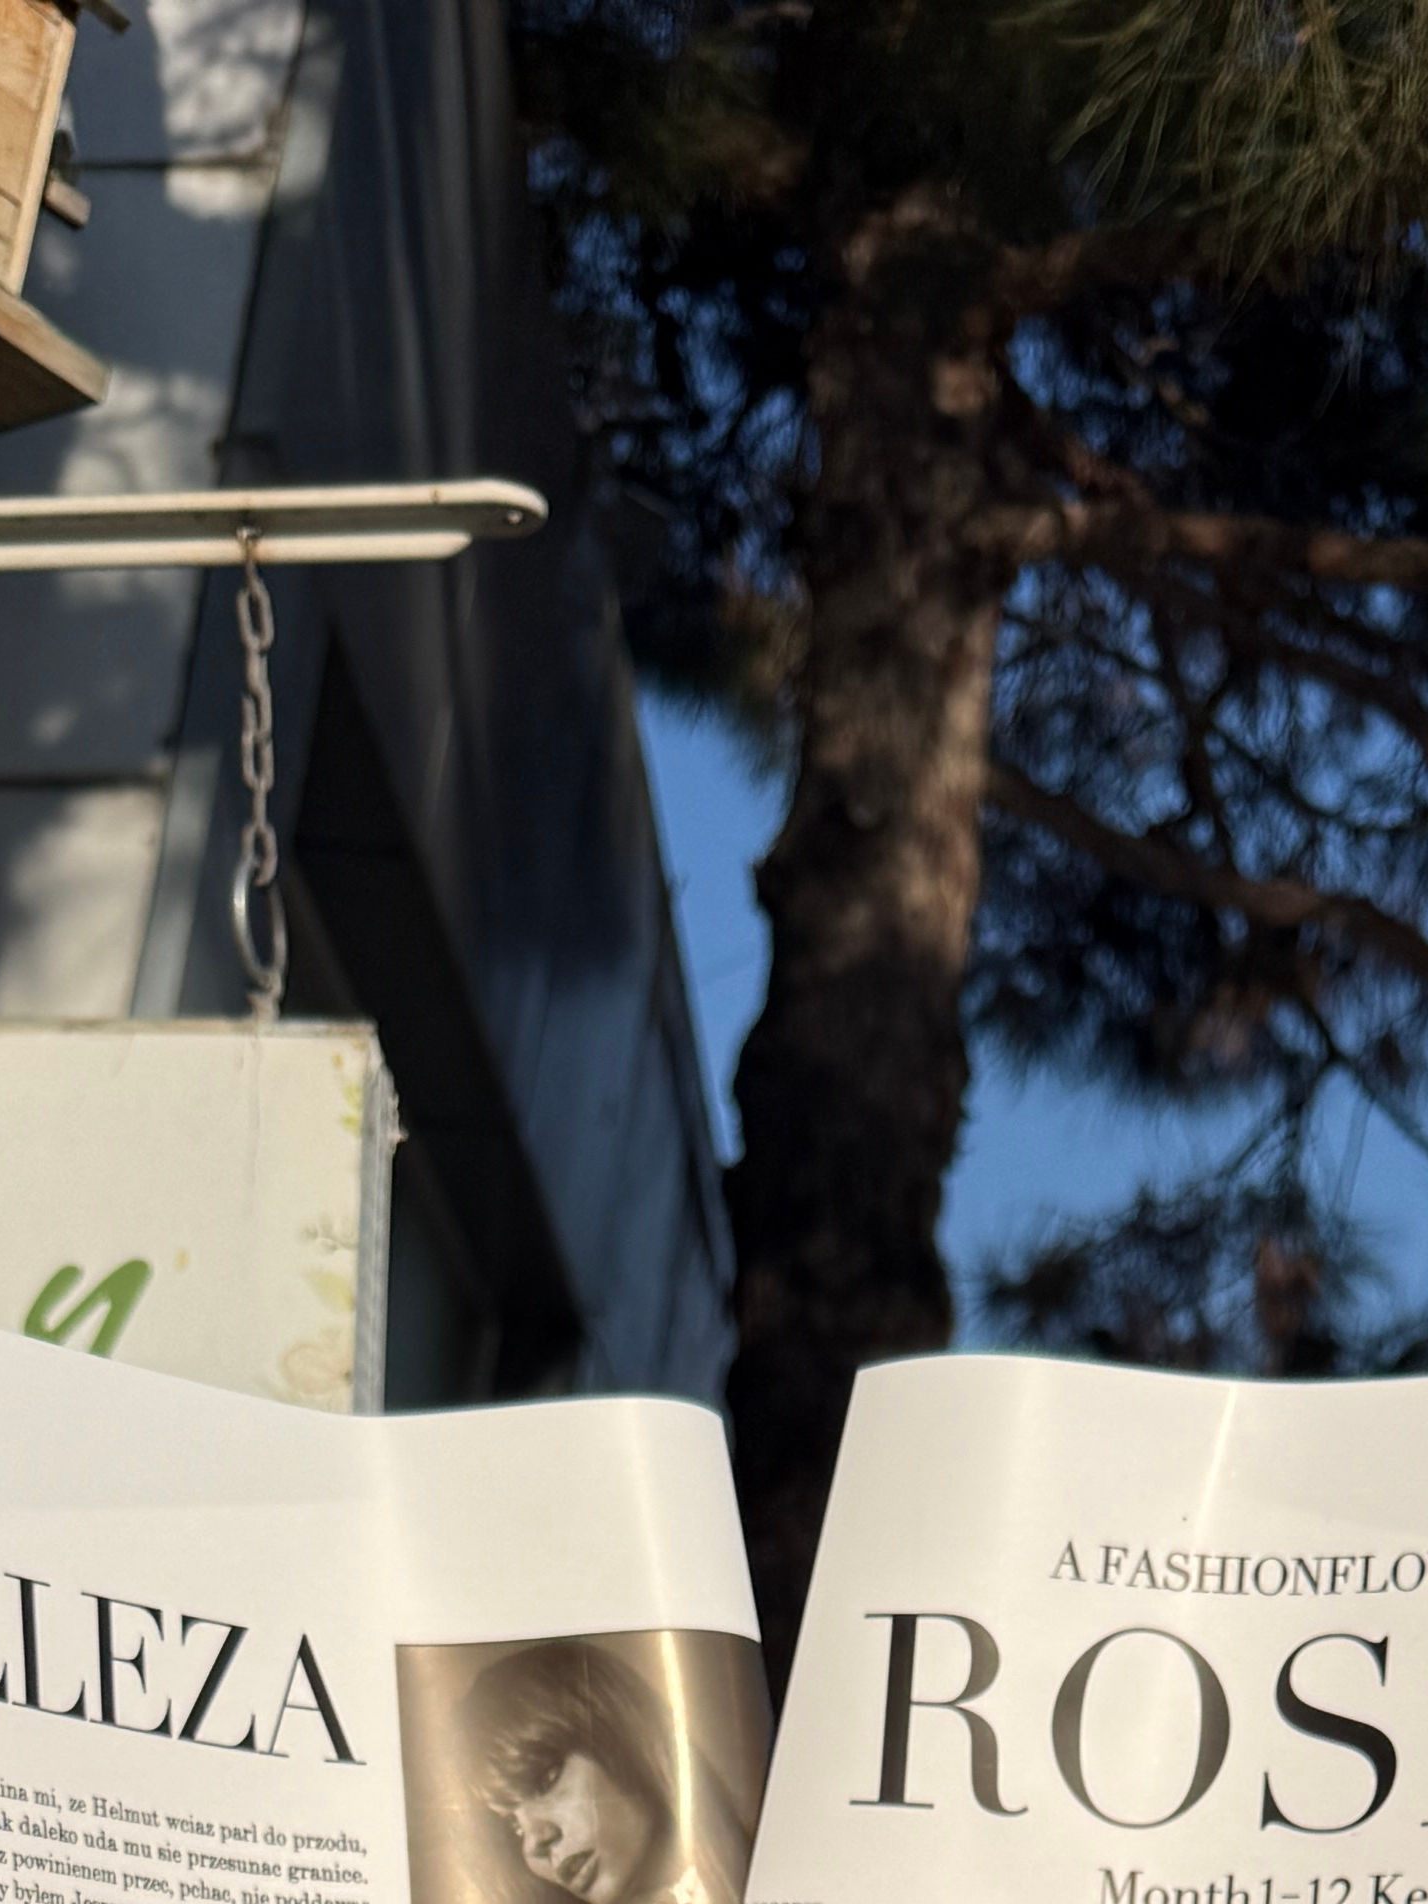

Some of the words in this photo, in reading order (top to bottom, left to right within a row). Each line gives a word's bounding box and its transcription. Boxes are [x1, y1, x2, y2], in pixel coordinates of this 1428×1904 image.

[1049, 1540, 1087, 1583] A
[18, 1815, 78, 1845] daleko
[82, 1829, 119, 1853] uda
[123, 1840, 152, 1859] mu
[157, 1842, 182, 1864] sie
[187, 1851, 282, 1878] przesunac
[287, 1863, 368, 1885] granice.
[33, 1788, 62, 1814] mi,
[68, 1797, 87, 1814] ze
[91, 1795, 160, 1828] Helmut
[165, 1815, 215, 1837] wciaz
[219, 1823, 258, 1844] parl
[262, 1825, 287, 1847] do
[292, 1832, 368, 1856] przodu,
[11, 1851, 117, 1885] powinienem
[122, 1872, 174, 1898] przec,
